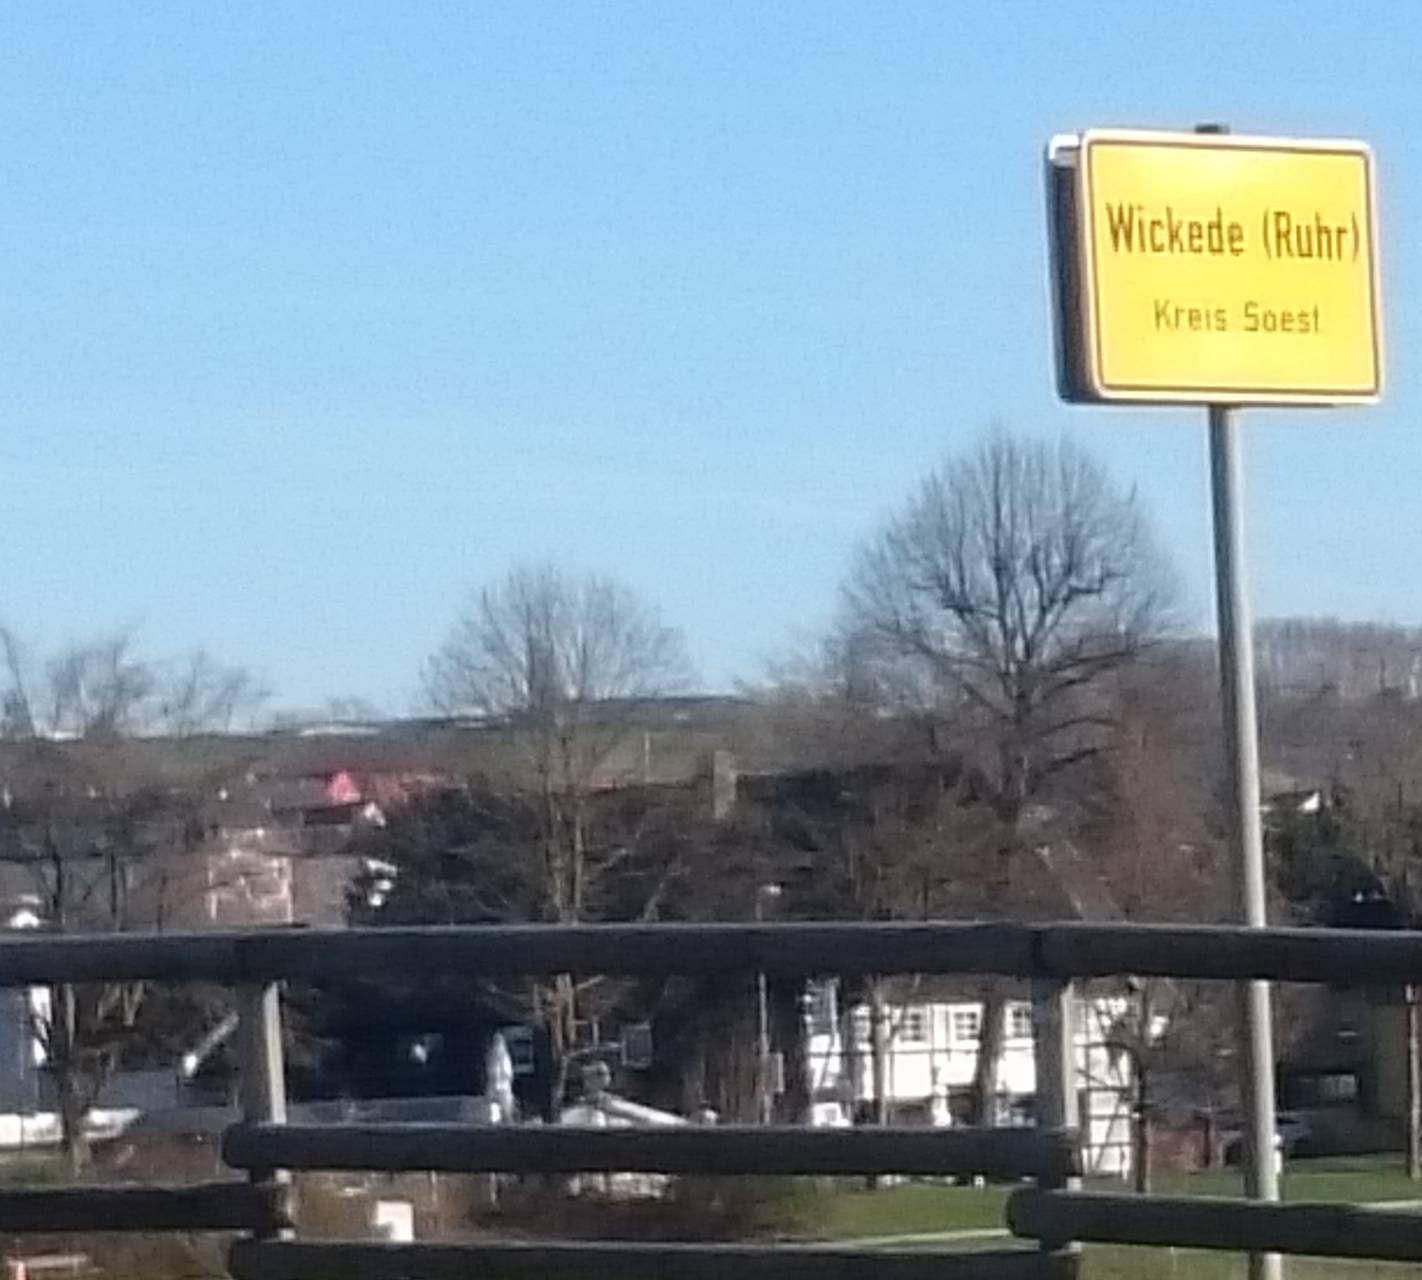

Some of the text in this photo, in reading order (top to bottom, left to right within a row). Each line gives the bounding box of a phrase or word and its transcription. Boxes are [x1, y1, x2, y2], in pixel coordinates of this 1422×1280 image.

[1105, 203, 1361, 261] Wickede (Ruhr)
[1153, 299, 1320, 333] Kreis Soest
